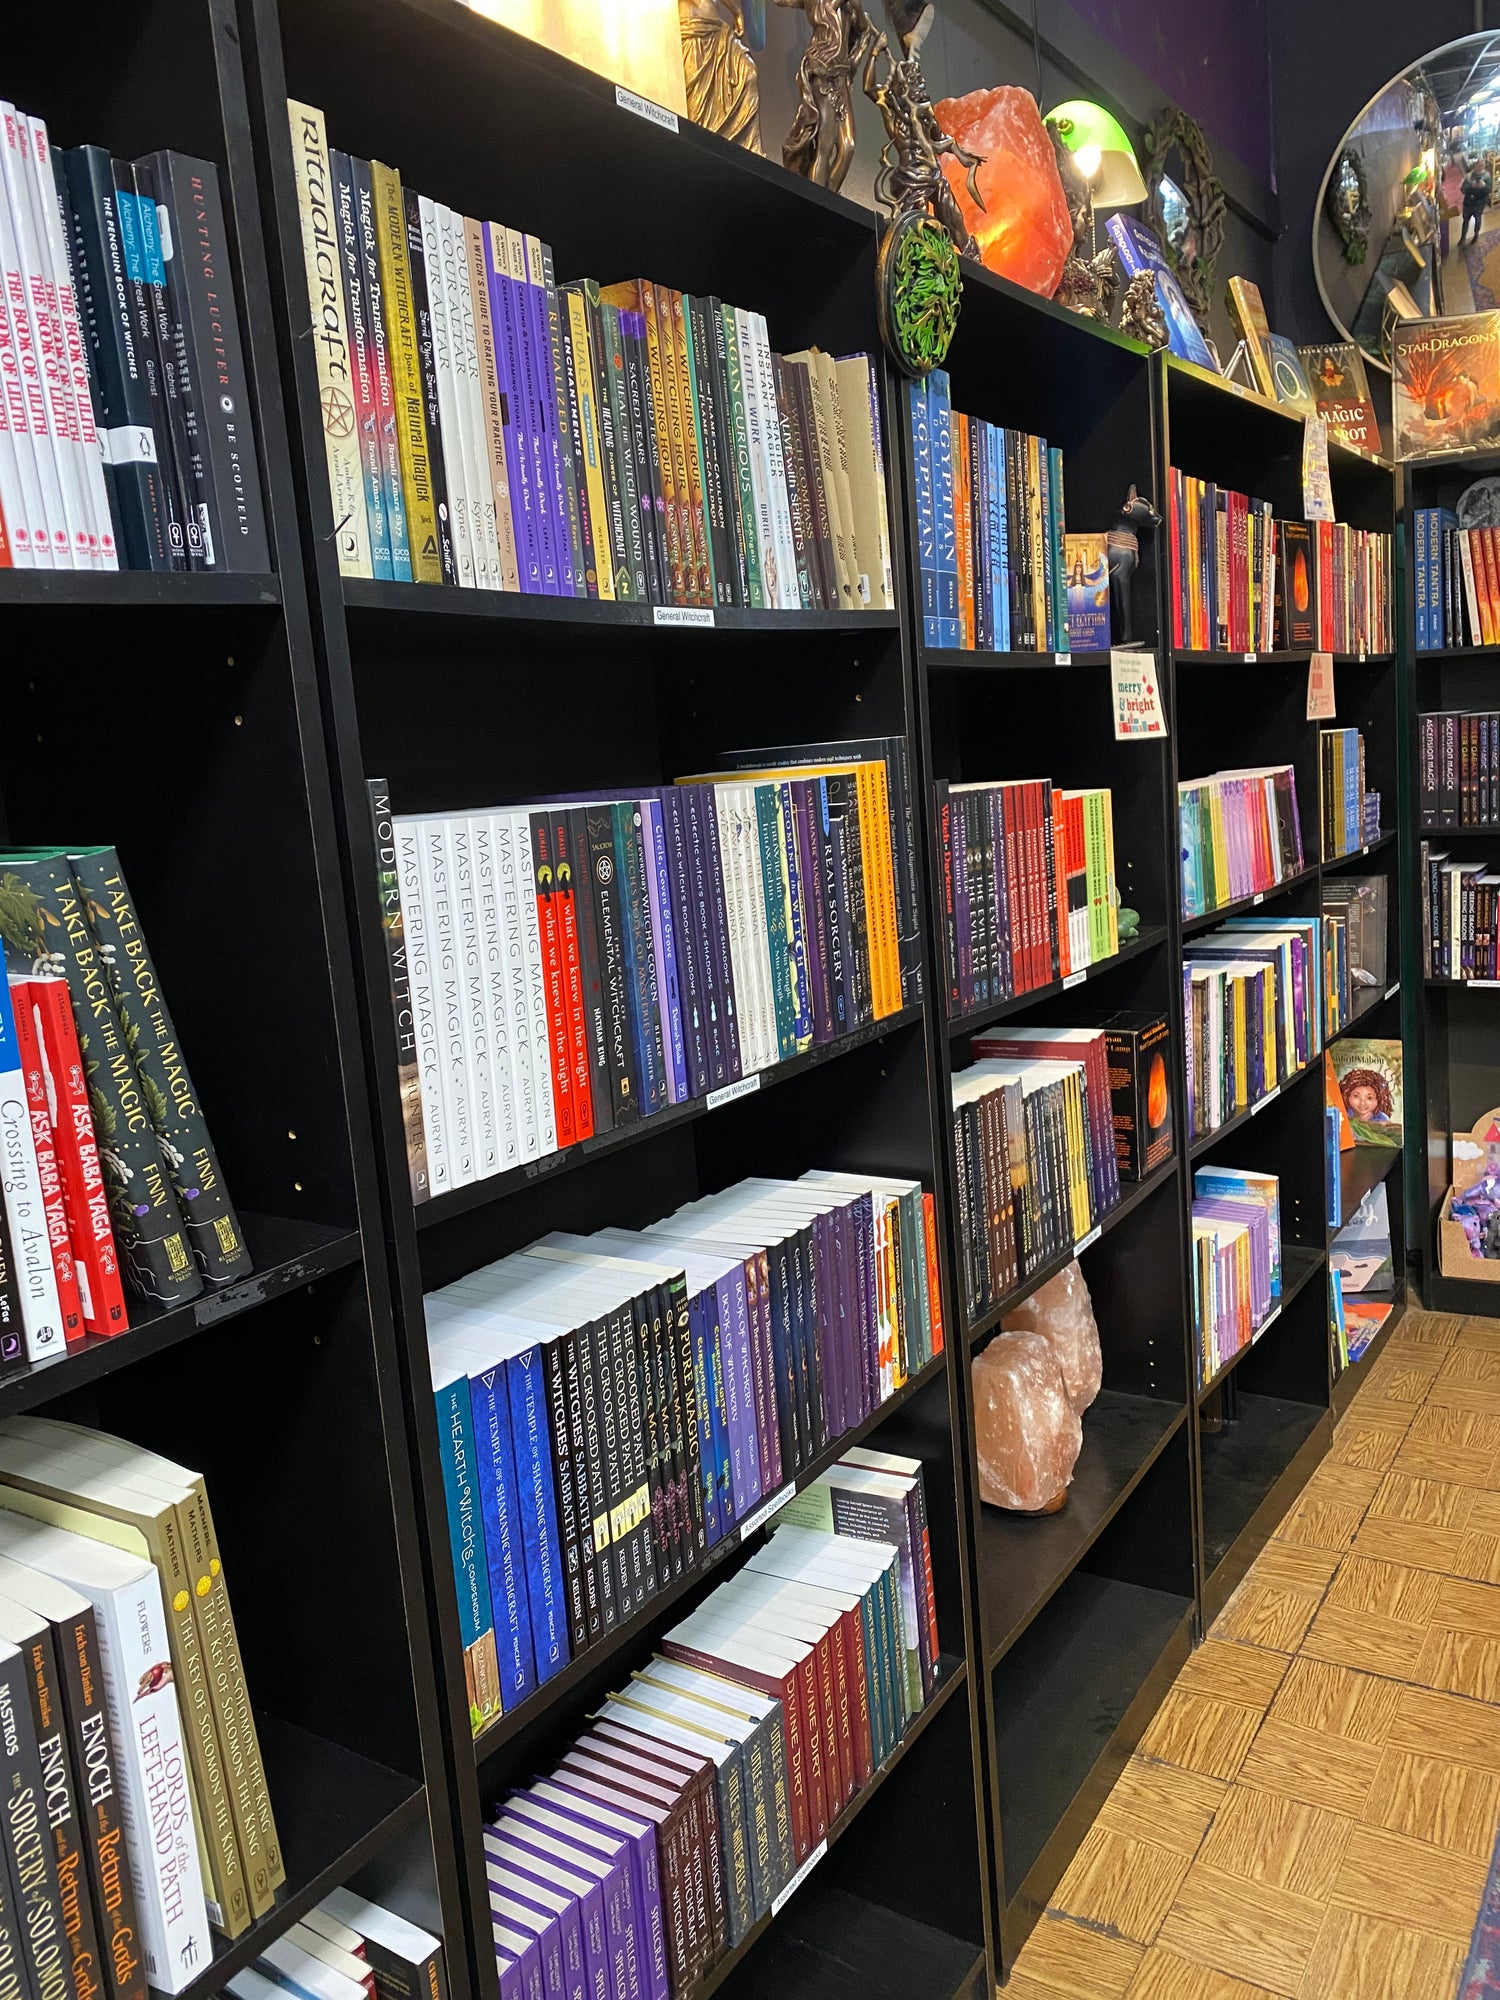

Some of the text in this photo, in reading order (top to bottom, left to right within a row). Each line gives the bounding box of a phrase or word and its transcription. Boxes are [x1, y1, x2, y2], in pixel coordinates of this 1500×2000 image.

[618, 90, 676, 127] General Witchcraft
[386, 182, 395, 201] The
[388, 206, 403, 261] MODERN
[103, 196, 138, 380] THE PENGUIN BOOK OF WITCHES
[150, 257, 159, 276] The
[154, 279, 164, 312] Great
[191, 176, 228, 385] HUNTING LUCIFER
[359, 189, 390, 407] Magick for Transformation
[474, 246, 485, 288] WITCH'S
[157, 313, 169, 340] Work
[395, 265, 413, 352] WITCHCRAFT
[478, 291, 488, 321] GUIDE
[482, 324, 490, 336] TO
[58, 285, 97, 444] THE BOOK OF LILITH
[403, 354, 416, 379] Book
[425, 218, 466, 540] YOUR ALTAR Kynes
[484, 339, 495, 388] CRAFTING
[572, 310, 589, 388] RITUALS
[1323, 345, 1355, 354] GRAHAM
[409, 381, 417, 394] of
[490, 391, 498, 416] YOUR
[564, 335, 582, 456] ENCHANTMENTS
[726, 317, 741, 393] PAGAN
[734, 401, 751, 492] CURIOUS
[740, 323, 760, 444] THE LITTLE WORK
[405, 396, 422, 451] Natural
[492, 420, 503, 466] PRACTICE
[602, 406, 614, 448] HEALING
[680, 353, 695, 438] WITCHING
[688, 444, 700, 489] HOUR
[1320, 408, 1364, 423] MAGIC
[226, 423, 249, 535] BE SCOFIELD
[611, 483, 618, 496] OF
[617, 378, 642, 562] HEAL THE WITCH WOUND
[938, 407, 955, 562] EGYPTIAN
[971, 425, 979, 500] CERRIDWEN
[611, 500, 625, 559] WITCHCRAFT
[1430, 512, 1438, 560] MODERN
[657, 611, 711, 623] General Witchcraft
[1118, 682, 1142, 697] merry
[1119, 698, 1154, 714] & bright
[655, 824, 664, 865] Circle,
[659, 869, 667, 905] Coven
[664, 909, 670, 919] &
[825, 845, 843, 983] REAL SORCERY
[374, 795, 423, 1153] MODERN WITCH HUNTER
[401, 837, 438, 1078] MASTERING MAGICK
[600, 890, 624, 1068] ELEMENTAL WITCHCRAFT
[104, 871, 195, 1119] TAKE BACK THE MAGIC
[565, 904, 588, 1088] what we knew in the night
[709, 1080, 758, 1105] General Witchcraft
[430, 1104, 442, 1154] AURYN
[1, 1100, 52, 1299] Crossing to Avalon
[71, 1104, 110, 1242] ASK BABA YAGA
[193, 1147, 217, 1191] FINN
[525, 1372, 533, 1392] THE
[680, 1329, 699, 1457] PURE MAGIC
[525, 1394, 538, 1445] TEMPLE
[551, 1349, 576, 1542] THE WITCHES' SABBATH
[579, 1334, 604, 1508] THE CROOKED PATH
[532, 1461, 545, 1528] SHAMANIC
[164, 1523, 181, 1578] MATHERS
[537, 1525, 554, 1607] WITCHCRAFT
[137, 1600, 152, 1655] FLOWERS
[571, 1578, 582, 1620] KELDEN
[81, 1711, 113, 1807] ENOCH
[180, 1614, 238, 1877] THE KEY OF SOLOMON THE KING
[786, 1674, 802, 1796] DIVINE DIRT
[138, 1714, 184, 1927] LEFT-HAND PATH
[161, 1741, 190, 1873] LORDS of the
[97, 1826, 121, 1913] Return
[110, 1928, 137, 1986] Gods
[651, 1905, 664, 1980] SPELLCRAFT
[672, 1887, 687, 1972] WITCHCRAFT
